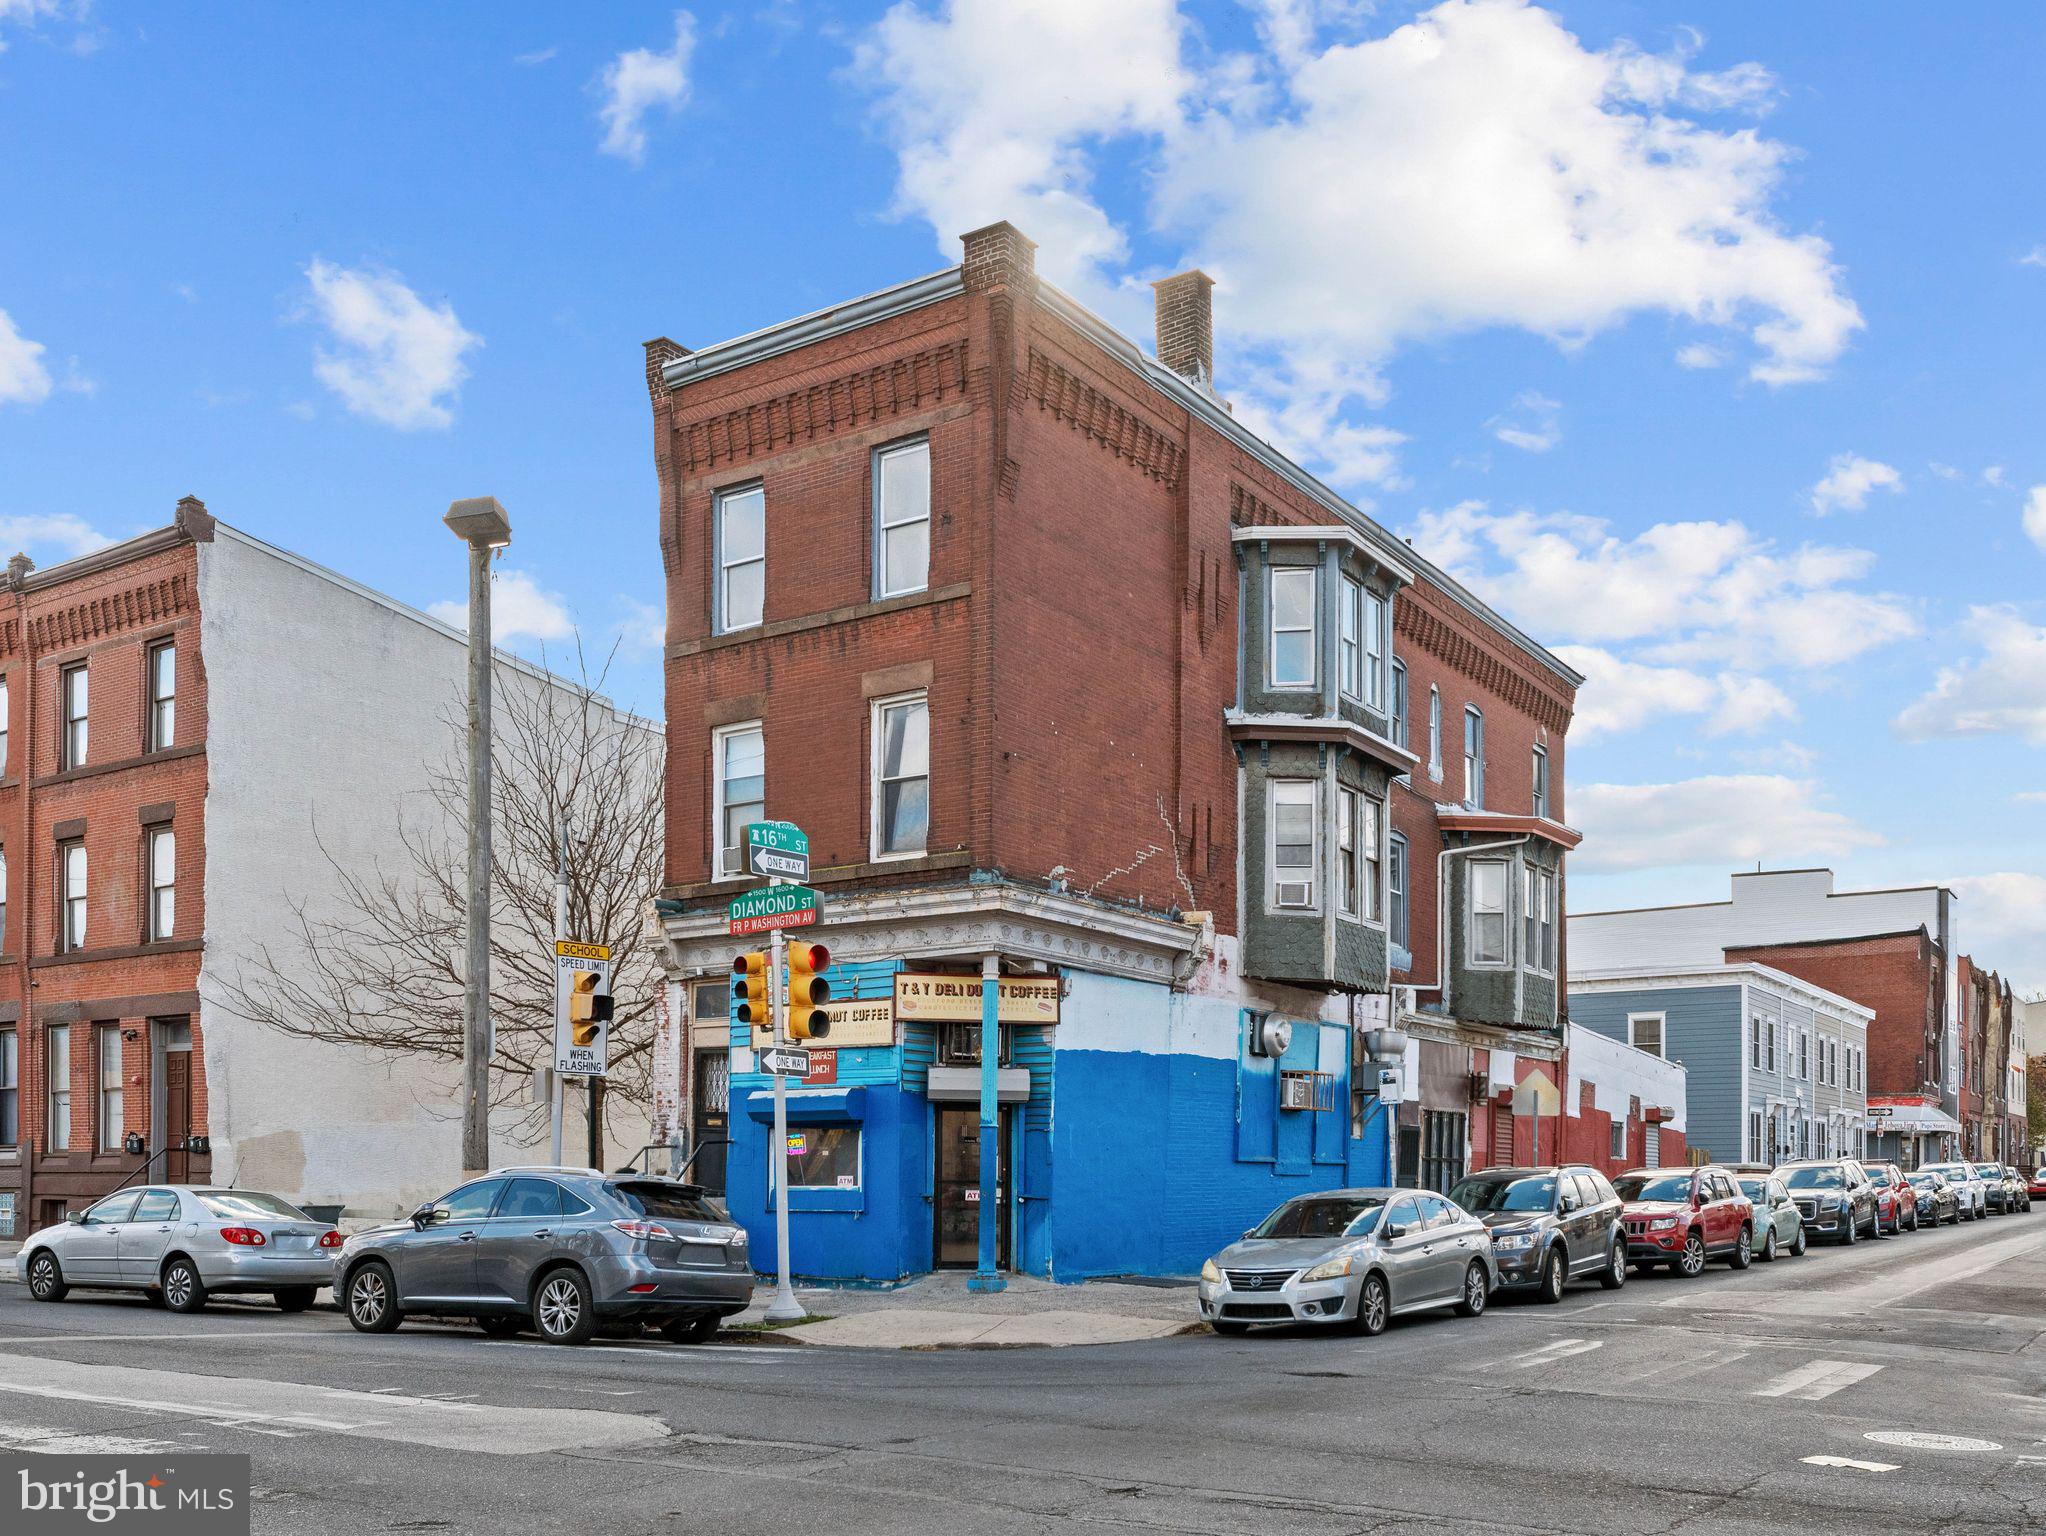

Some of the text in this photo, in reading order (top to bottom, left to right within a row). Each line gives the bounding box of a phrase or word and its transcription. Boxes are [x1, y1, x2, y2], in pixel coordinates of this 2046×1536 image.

[761, 828, 807, 851] 16TH ST
[767, 856, 802, 872] ONE WAY
[767, 887, 774, 896] W
[733, 895, 812, 918] DIAMOND ST
[732, 921, 742, 933] FR
[751, 913, 800, 931] WASHINGTON
[802, 911, 813, 923] AV
[563, 944, 603, 958] SCHOOL
[560, 957, 606, 972] SPEED LIMIT
[900, 983, 1057, 999] T & Y DELI DOT COFFEE
[852, 1008, 889, 1022] COFFEE
[569, 1049, 594, 1061] WHEN
[775, 1056, 805, 1068] ONE WAY
[560, 1060, 602, 1072] FLASHING
[787, 1138, 804, 1147] OPEN
